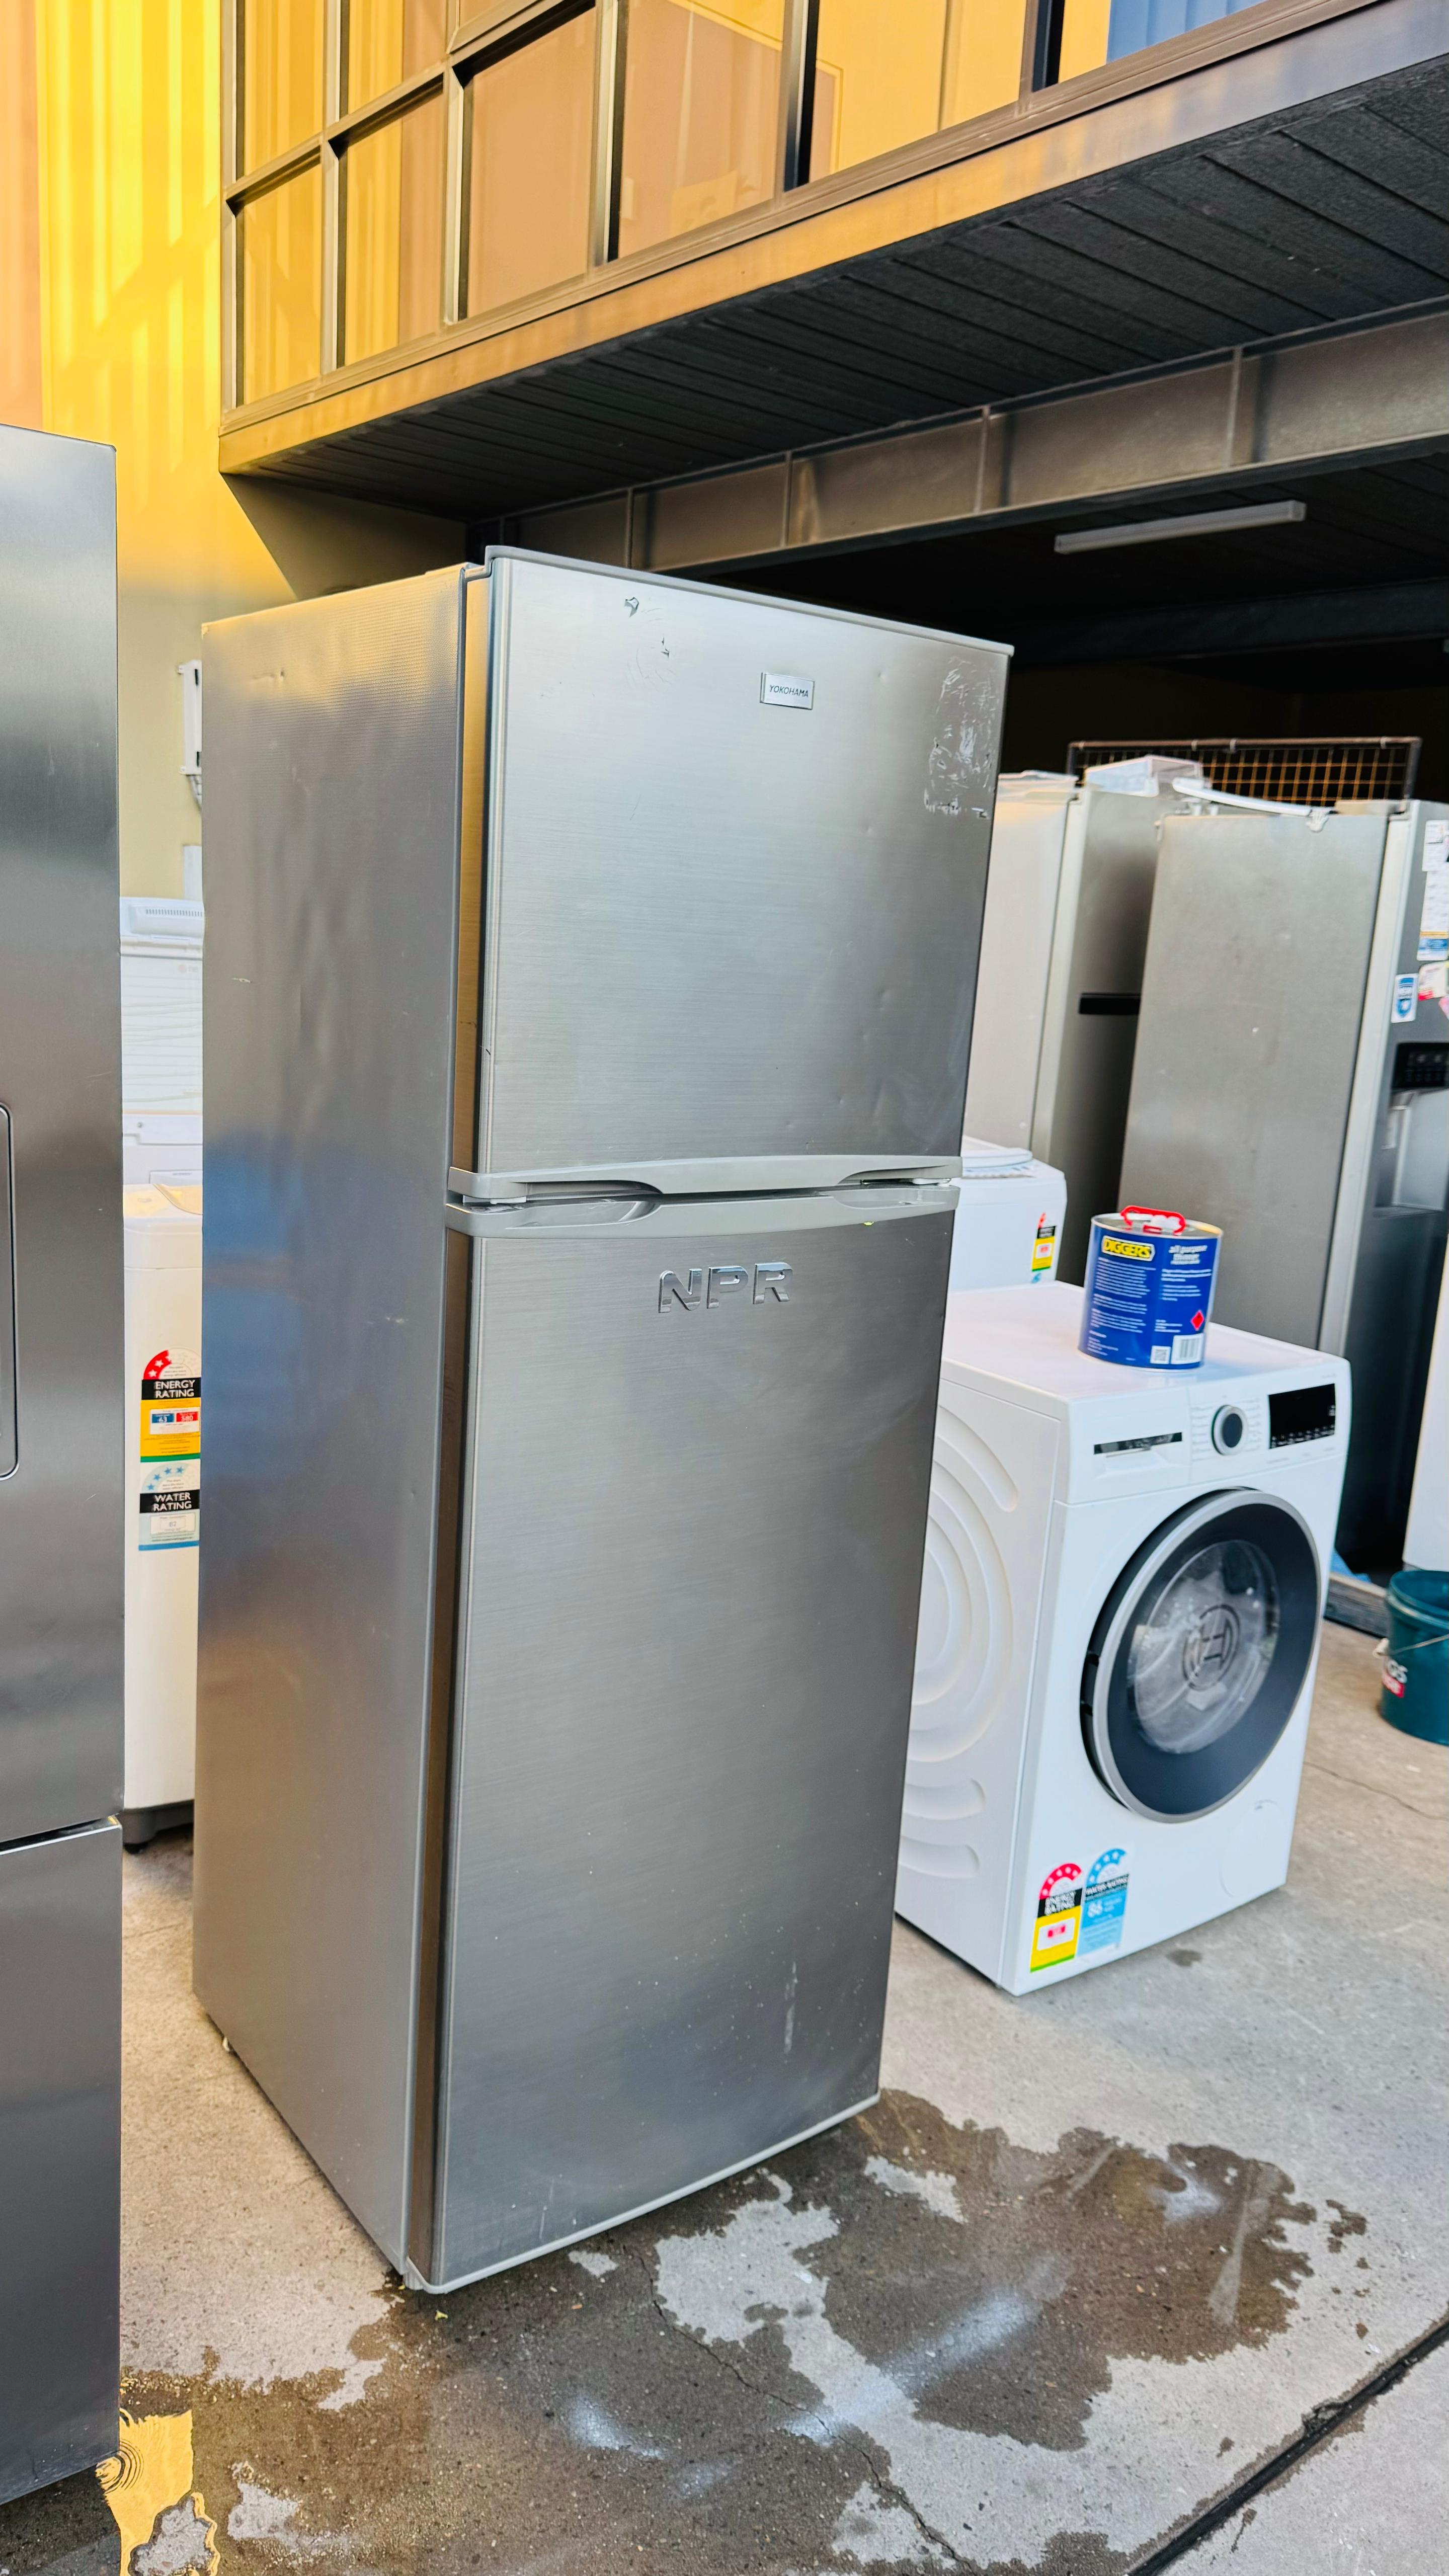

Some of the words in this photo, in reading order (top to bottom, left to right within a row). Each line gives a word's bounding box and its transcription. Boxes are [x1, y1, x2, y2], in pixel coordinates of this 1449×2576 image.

[770, 685, 809, 697] YOKOHAMA
[1104, 1238, 1151, 1258] DIGGERS
[658, 1262, 793, 1313] NPR
[155, 1380, 195, 1390] ENERGY
[155, 1389, 194, 1399] RATING
[154, 1492, 191, 1502] WATER
[153, 1501, 192, 1511] RATING
